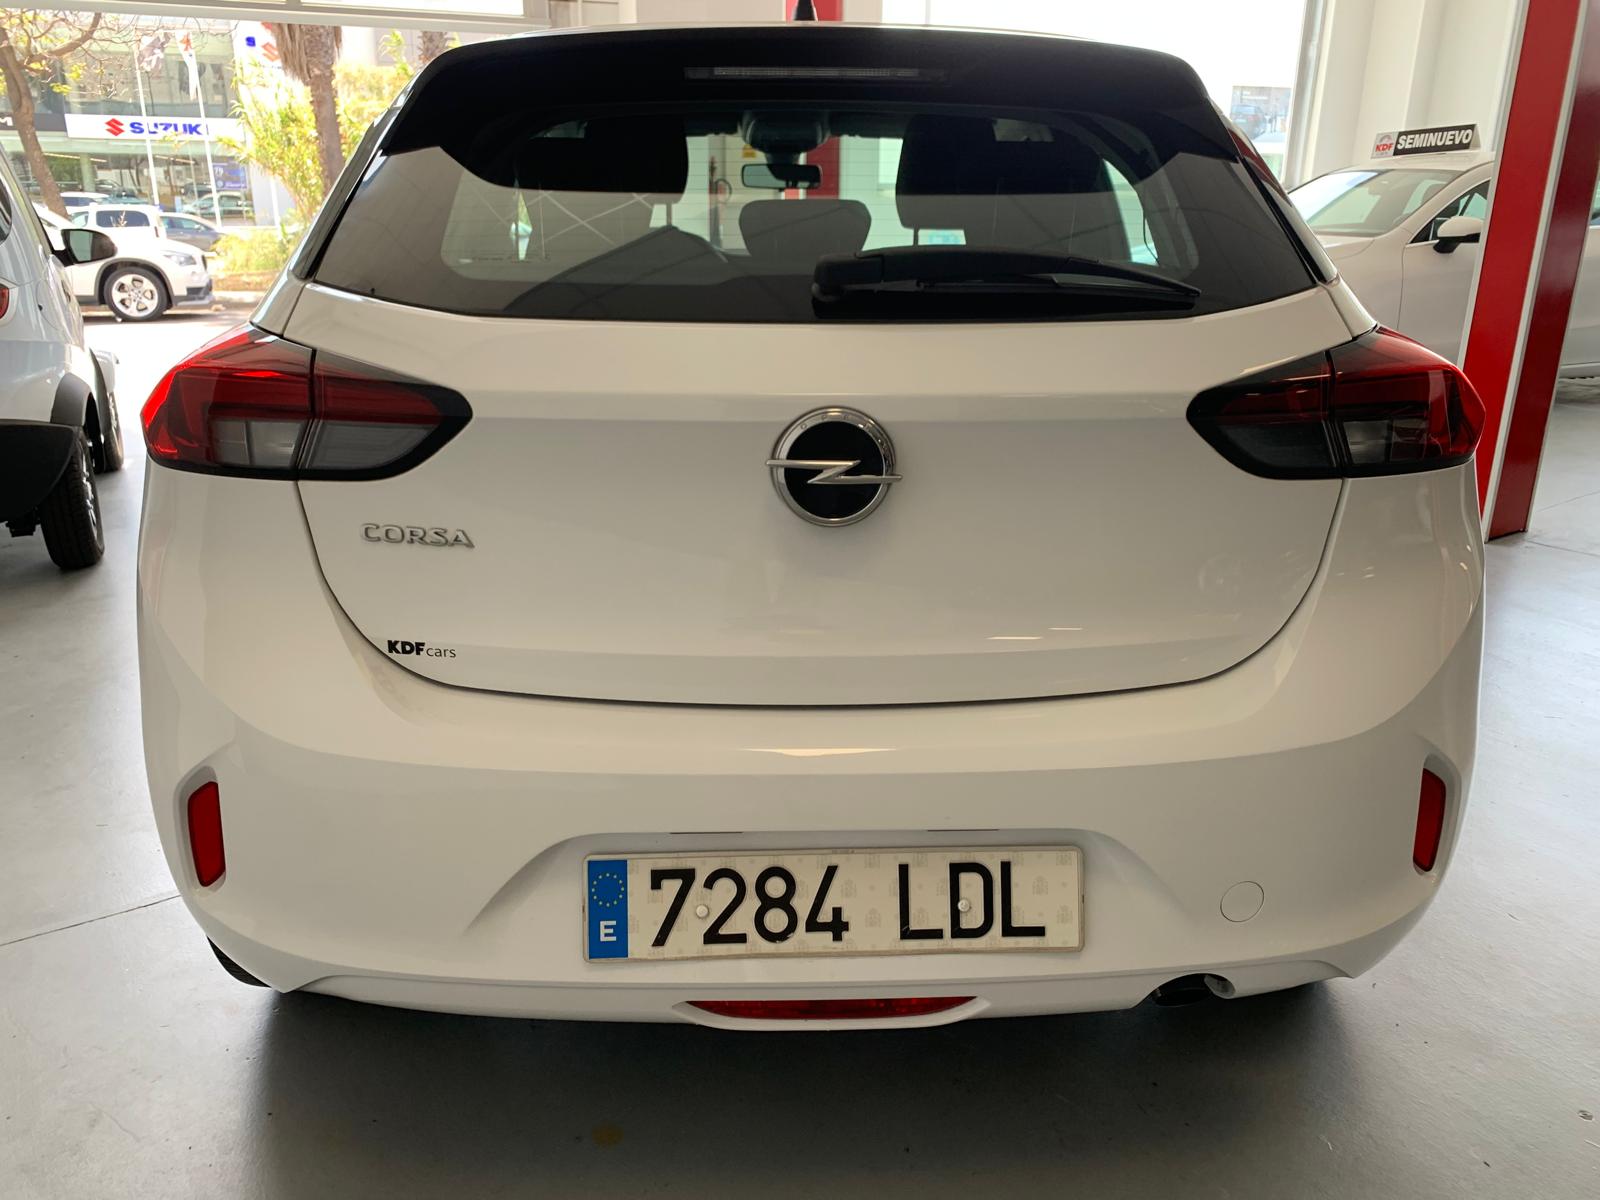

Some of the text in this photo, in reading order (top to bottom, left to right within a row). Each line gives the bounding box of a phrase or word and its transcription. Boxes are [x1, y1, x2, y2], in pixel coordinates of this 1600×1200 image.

[1375, 143, 1394, 152] KDF
[1397, 129, 1473, 150] SEMINUEVO
[361, 523, 475, 548] CORSA
[651, 860, 1045, 947] 7284 LDL
[600, 921, 616, 941] E
